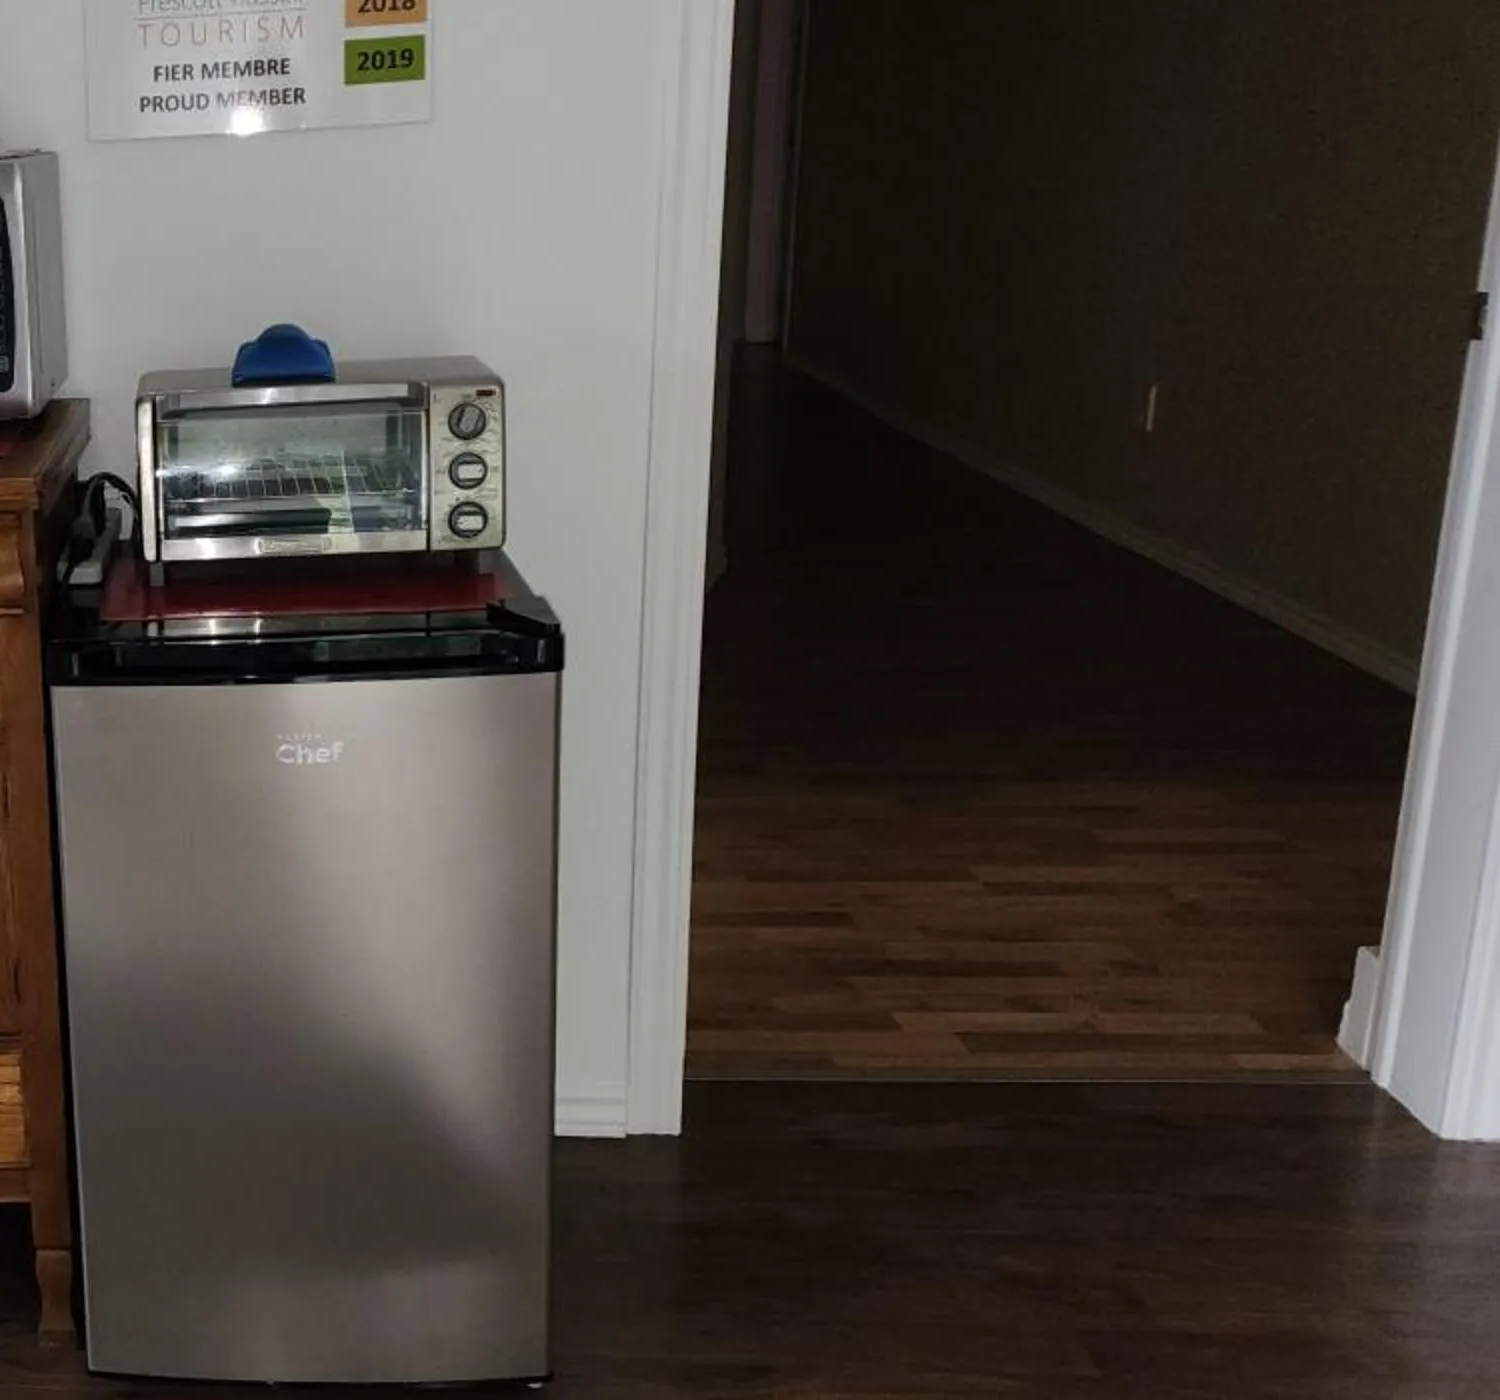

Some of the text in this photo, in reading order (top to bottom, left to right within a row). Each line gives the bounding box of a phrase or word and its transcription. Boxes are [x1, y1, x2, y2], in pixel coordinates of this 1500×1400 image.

[137, 16, 304, 48] TOURISM
[153, 57, 291, 83] FIER MEMBRE
[356, 47, 414, 72] 2019
[139, 87, 307, 113] PROUD MEMBER
[275, 741, 344, 764] Chef
